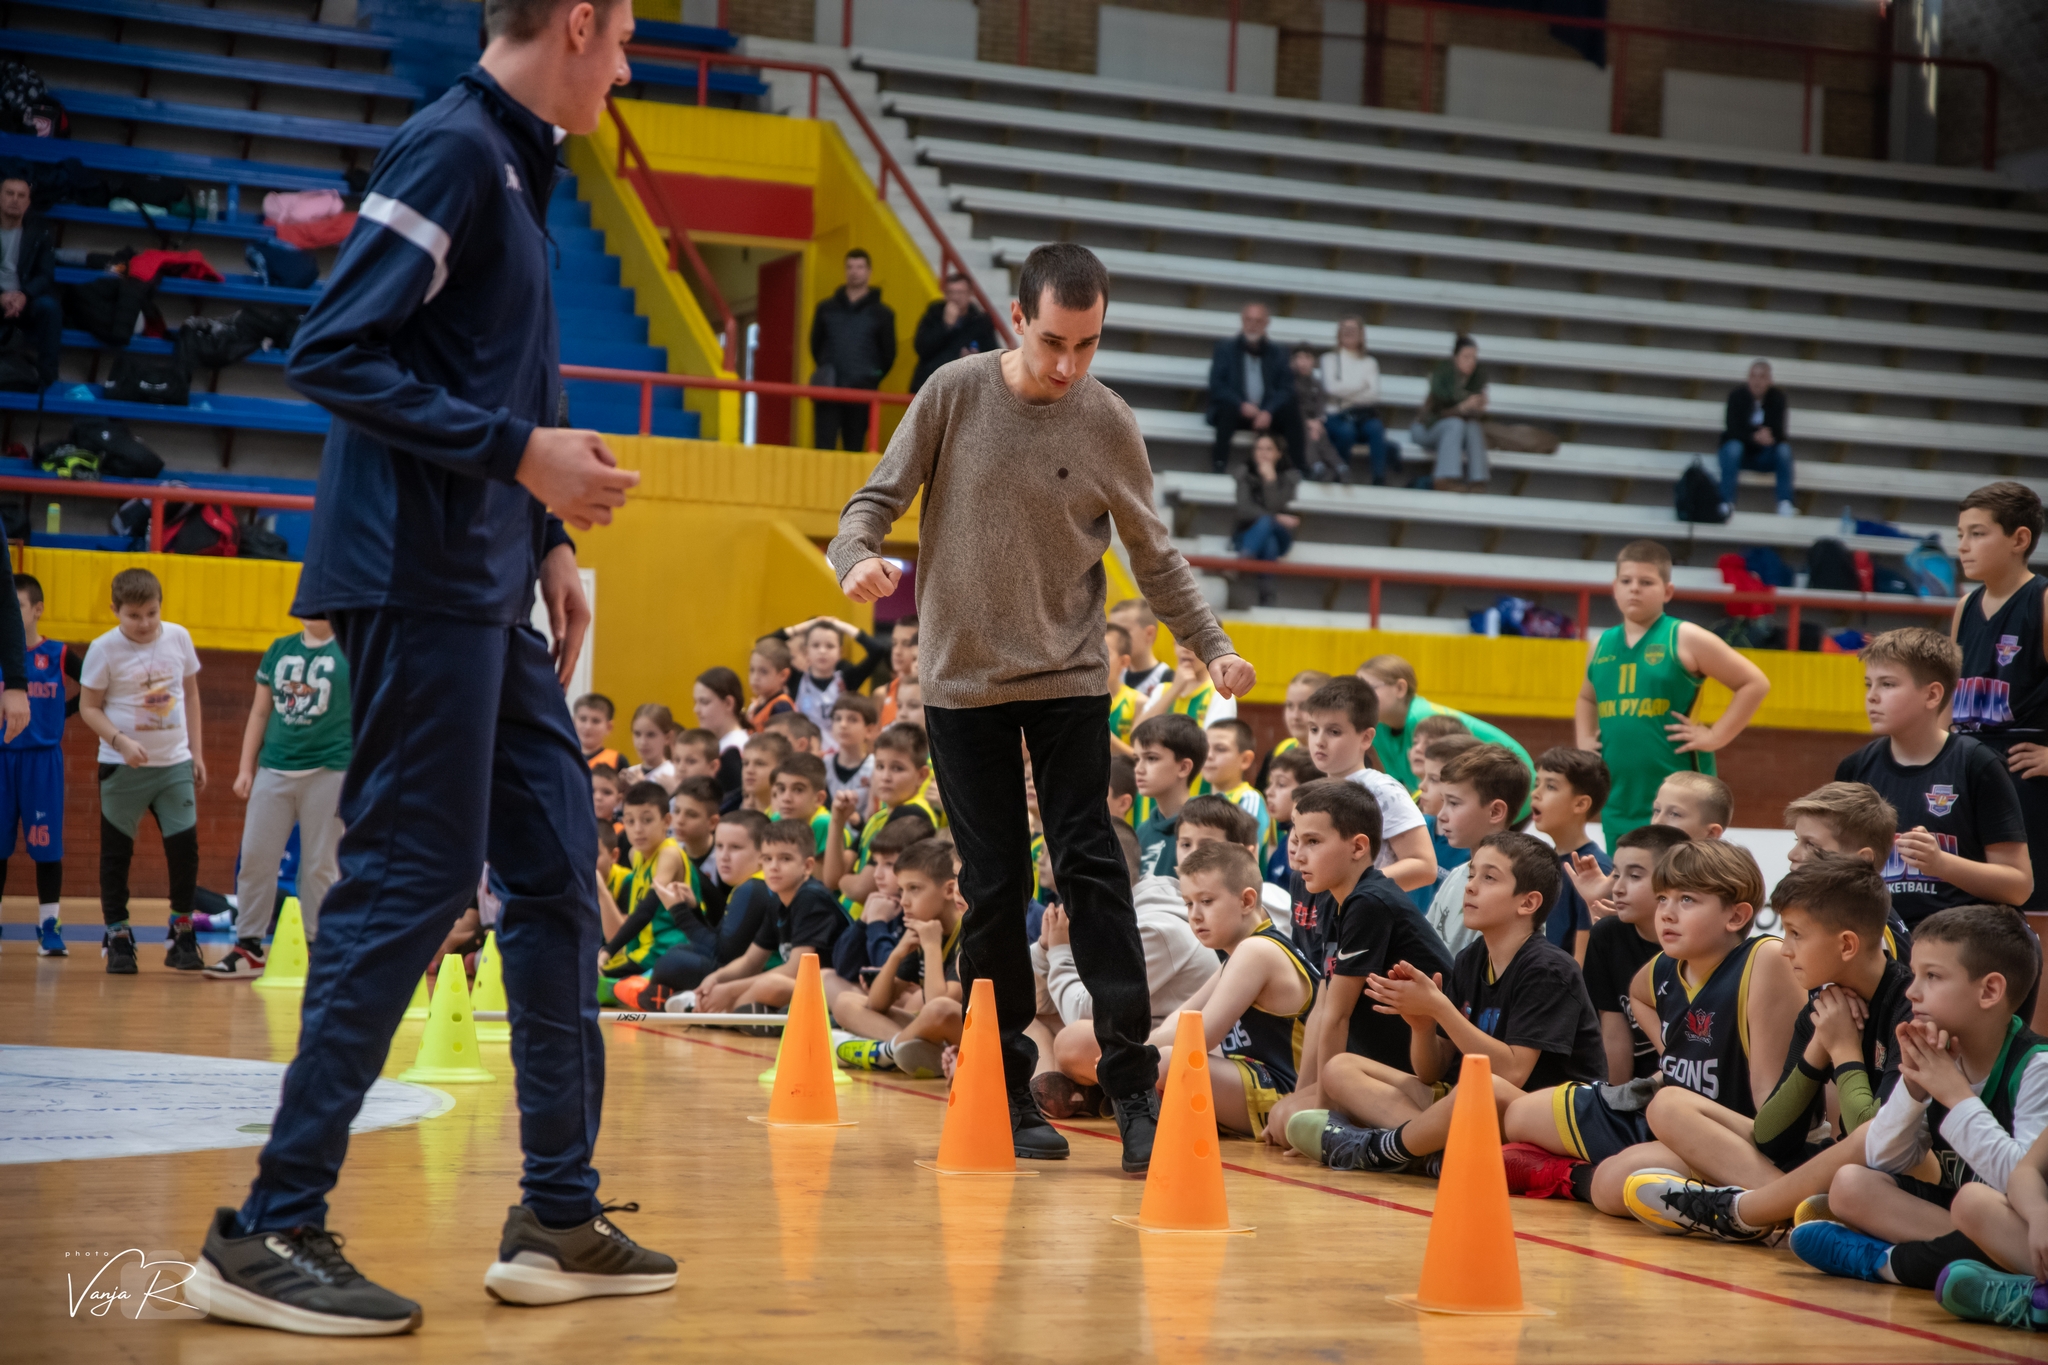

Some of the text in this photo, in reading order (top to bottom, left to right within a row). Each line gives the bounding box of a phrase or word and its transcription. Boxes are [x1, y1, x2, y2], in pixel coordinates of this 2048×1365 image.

[1618, 662, 1637, 694] 11
[28, 824, 50, 847] 46
[1886, 881, 1938, 895] KETBALL
[616, 1013, 648, 1022] LISKI
[1659, 1055, 1719, 1100] GONS
